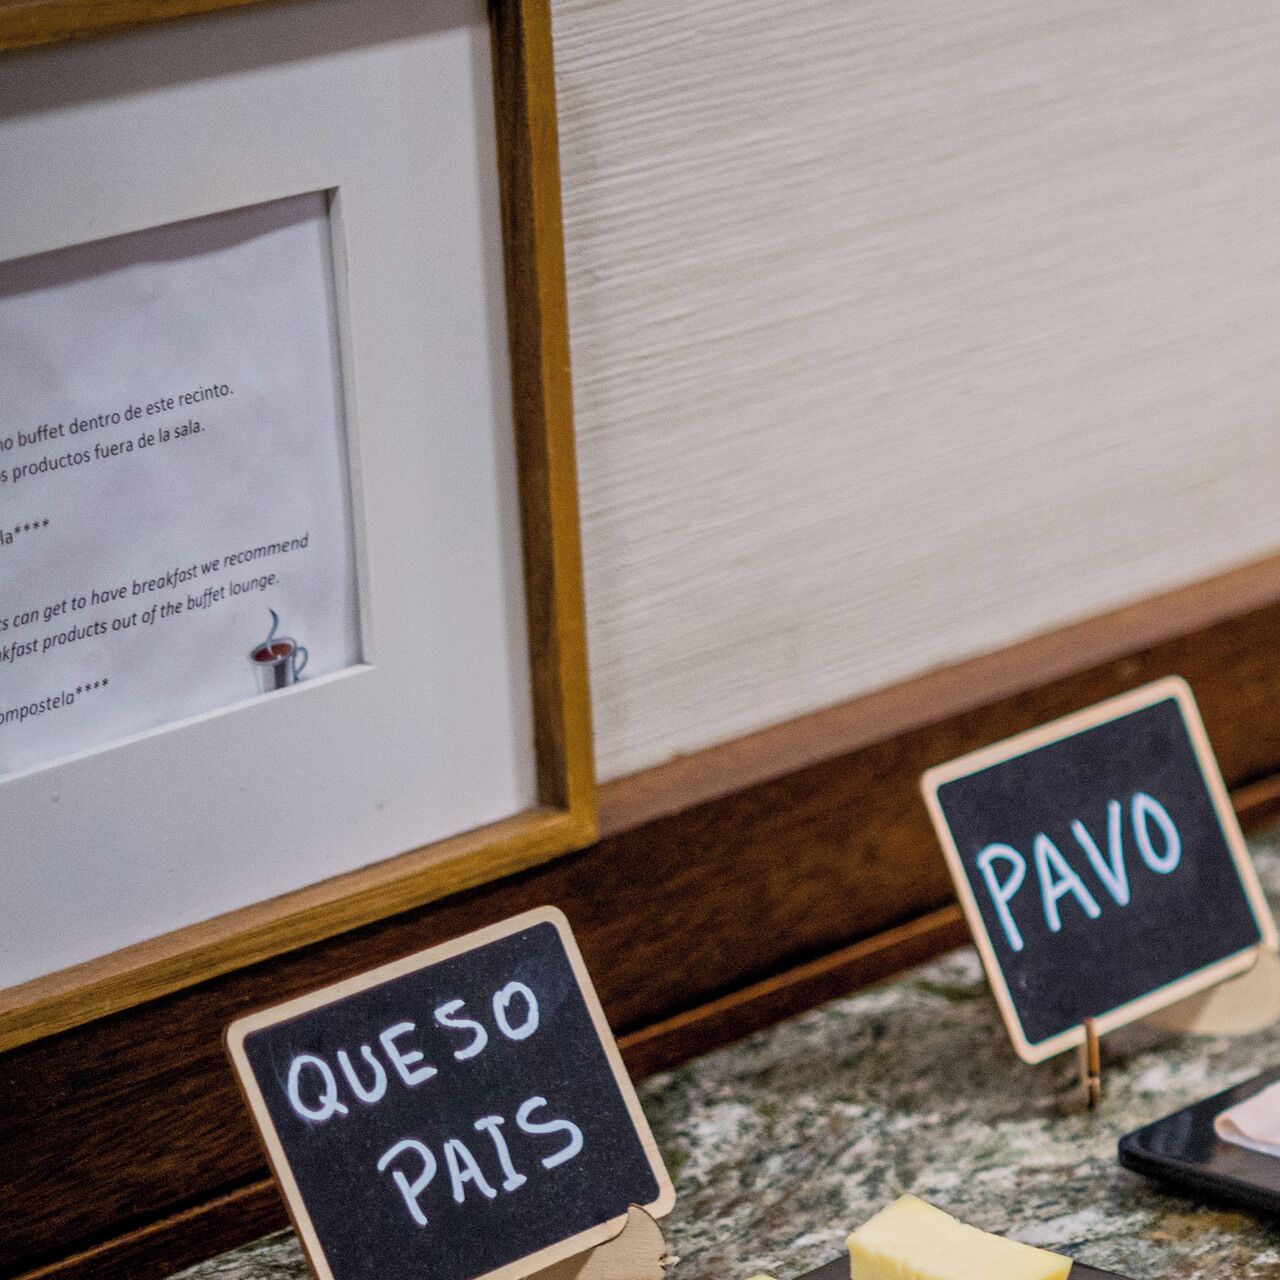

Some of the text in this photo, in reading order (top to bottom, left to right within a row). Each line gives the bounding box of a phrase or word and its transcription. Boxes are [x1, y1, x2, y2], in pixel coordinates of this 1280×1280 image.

[12, 456, 91, 483] productos
[94, 440, 133, 460] fuera
[137, 432, 155, 449] de
[158, 427, 170, 443] la
[174, 419, 205, 439] sala.
[17, 423, 65, 447] buffet
[69, 412, 121, 435] dentro
[124, 404, 142, 421] de
[146, 397, 175, 416] este
[178, 384, 234, 406] recinto.
[0, 572, 280, 664] kfast products out of the buffet lounge.
[13, 609, 39, 628] can
[43, 600, 68, 622] get
[71, 596, 87, 611] to
[91, 589, 128, 606] have
[132, 564, 198, 596] breakfast
[200, 558, 220, 575] we
[223, 532, 309, 568] recommend
[976, 791, 1183, 952] PAVO
[287, 980, 540, 1122] QUESO
[376, 1095, 585, 1227] PAIS
